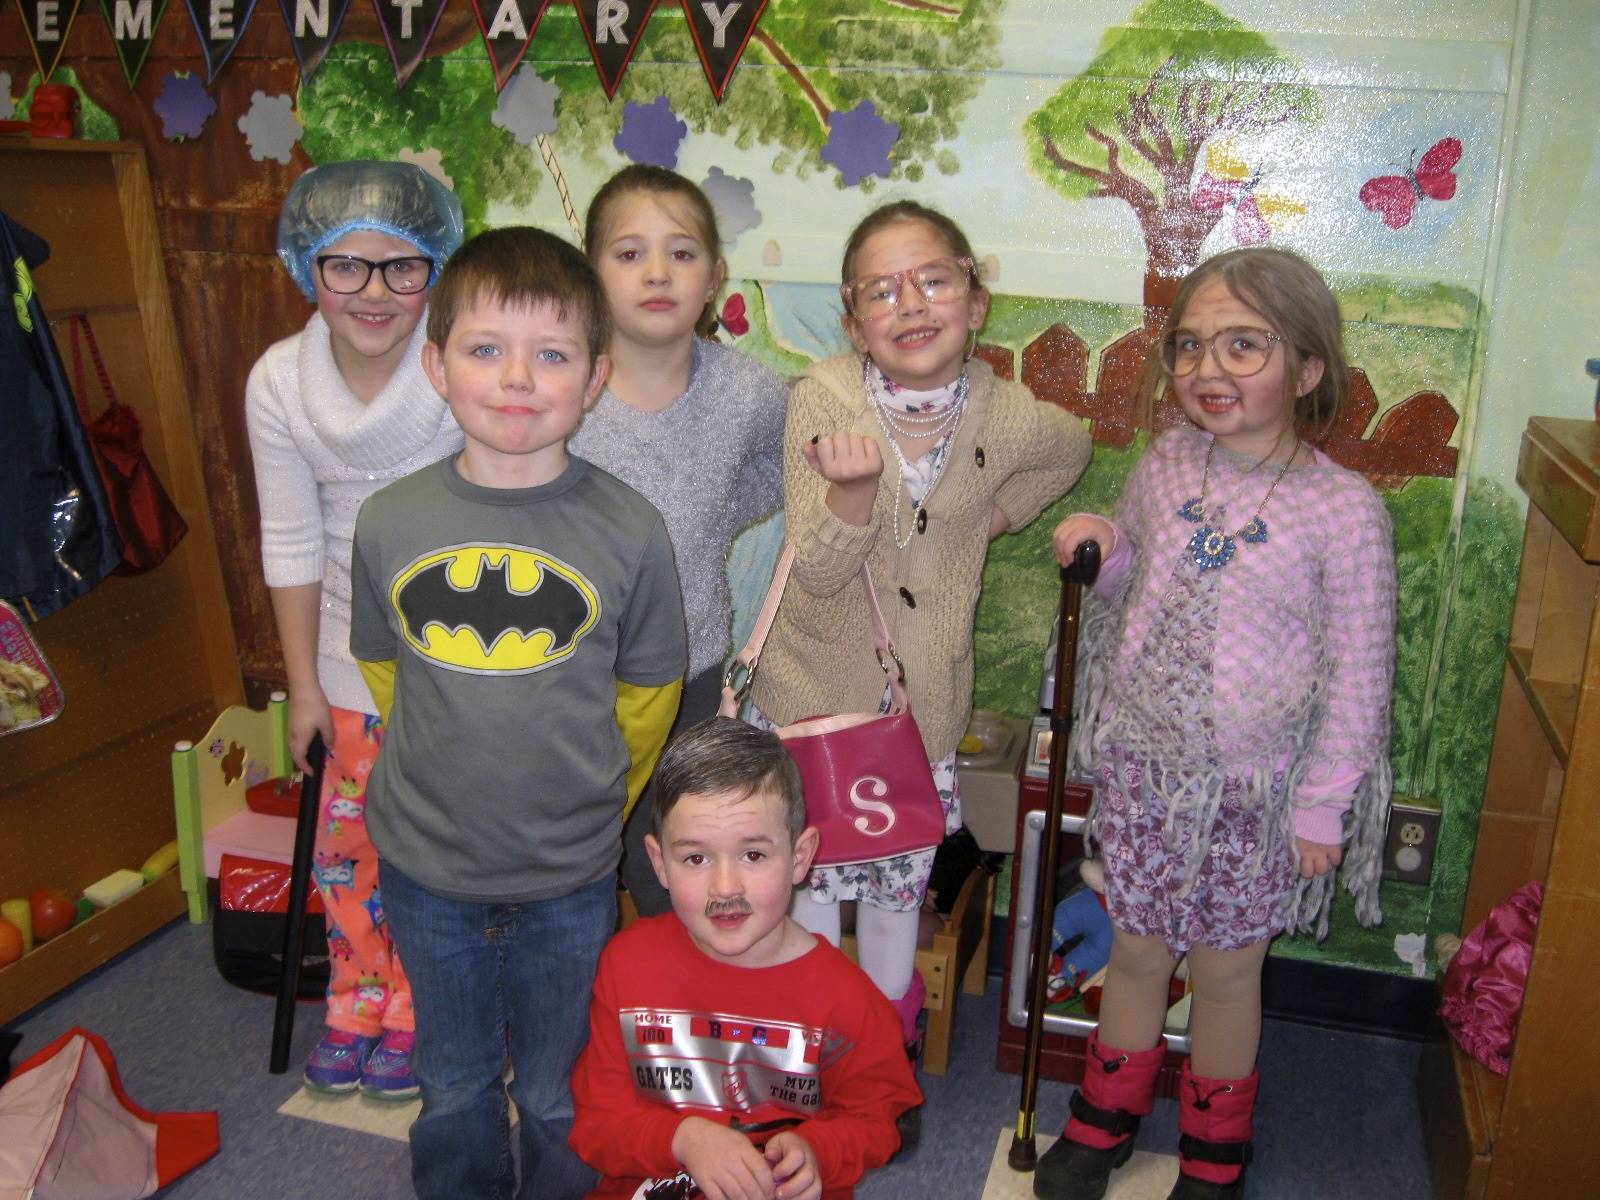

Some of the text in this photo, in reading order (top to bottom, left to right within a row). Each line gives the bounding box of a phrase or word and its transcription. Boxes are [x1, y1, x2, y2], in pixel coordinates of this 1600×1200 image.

[850, 777, 896, 836] S
[634, 1014, 673, 1025] HOME
[636, 1066, 693, 1091] GATES
[784, 1076, 816, 1091] MVP
